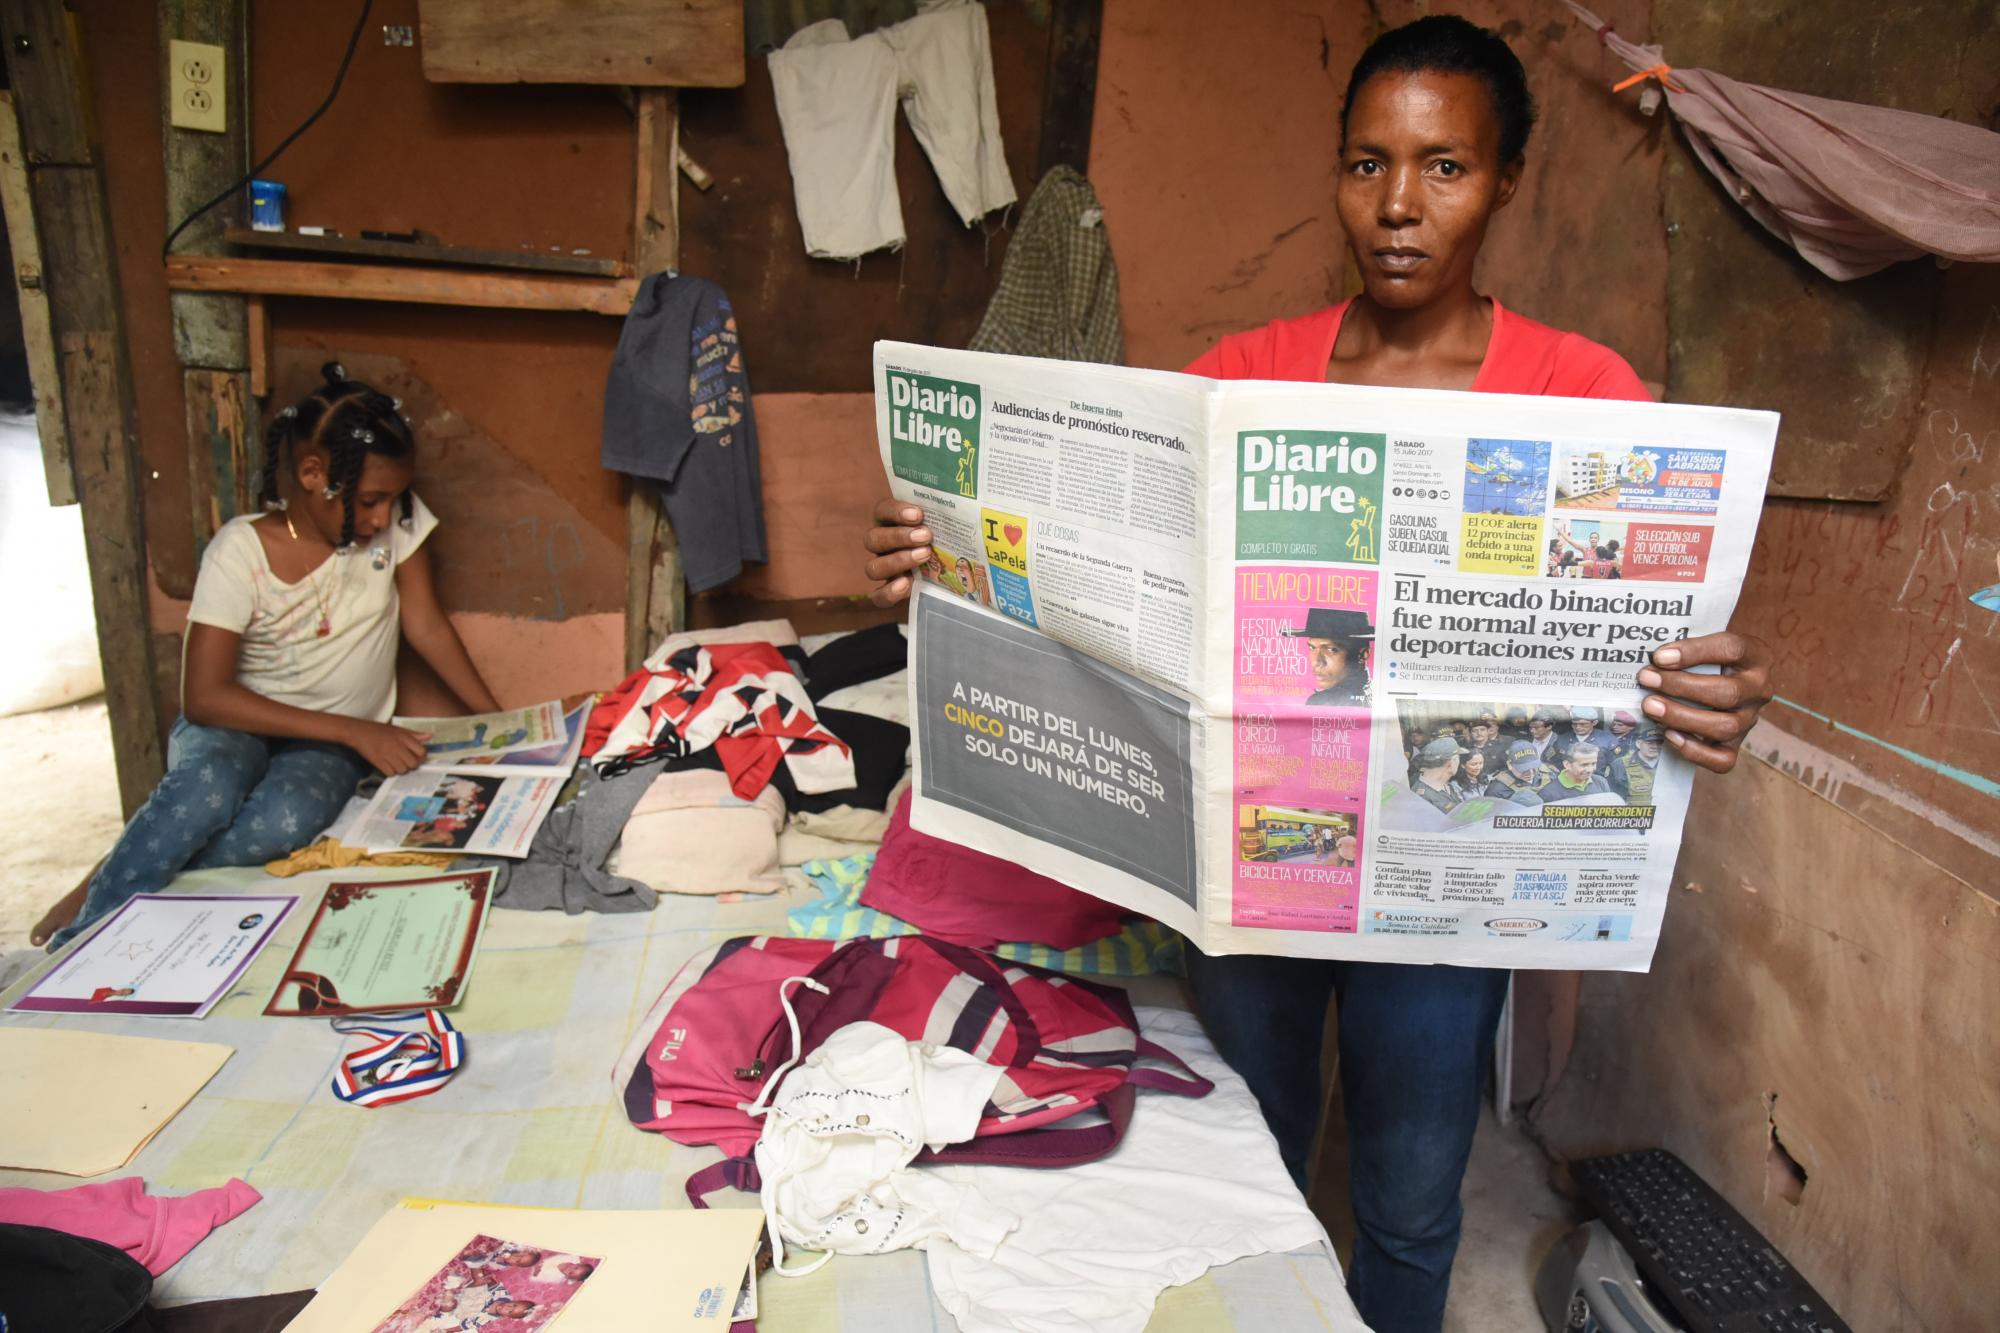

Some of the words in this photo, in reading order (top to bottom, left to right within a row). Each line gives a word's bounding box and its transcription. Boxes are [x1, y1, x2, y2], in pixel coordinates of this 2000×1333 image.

[891, 376, 976, 420] Diario
[1071, 401, 1080, 409] De
[1082, 402, 1104, 415] buena
[1106, 406, 1122, 418] tinta
[992, 401, 1049, 422] Audiencias
[1053, 411, 1065, 424] de
[1068, 416, 1129, 437] pronóstico
[894, 409, 961, 452] Libre
[1394, 440, 1424, 448] SÁBADO
[1244, 435, 1377, 475] Diario
[1667, 455, 1688, 463] SAN
[1690, 455, 1723, 464] ISIDRO
[1667, 462, 1721, 470] LABRADOR
[1243, 475, 1355, 513] Libre
[1390, 514, 1437, 528] GASOLINAS
[1468, 517, 1478, 527] El
[1481, 519, 1504, 528] COE
[1507, 520, 1537, 530] alerta
[986, 519, 998, 541] I
[1054, 526, 1079, 543] COSAS
[1420, 530, 1448, 542] GASOIL
[1467, 529, 1477, 537] 12
[1480, 530, 1535, 543] provincias
[1635, 530, 1681, 541] SELECCIÓN
[1683, 532, 1700, 543] SUB
[1241, 543, 1281, 554] COMPLETO
[1283, 544, 1288, 553] Y
[1290, 544, 1317, 555] GRATIS
[1388, 541, 1398, 551] SE
[1400, 542, 1426, 554] QUEDA
[1428, 544, 1450, 555] IGUAL
[1466, 539, 1501, 550] debido
[1513, 543, 1532, 552] una
[1634, 543, 1645, 553] 20
[1650, 544, 1687, 554] VOLEIBOL
[986, 546, 1026, 570] LaPela
[1037, 542, 1044, 550] Un
[1046, 545, 1070, 556] recuerdo
[1086, 555, 1110, 568] Segunda
[1112, 561, 1132, 573] Guerra
[1465, 551, 1491, 560] onda
[1494, 552, 1534, 563] tropical
[1633, 554, 1659, 565] VENCE
[1662, 554, 1698, 566] POLONIA
[1143, 570, 1161, 581] Buena
[1163, 575, 1185, 587] manera
[1151, 581, 1167, 591] pedir
[1168, 586, 1189, 598] perdón
[1240, 573, 1311, 601] TIEMPO
[1316, 575, 1371, 605] LIBRE
[1395, 580, 1419, 602] El
[1426, 587, 1543, 610] mercado
[1551, 582, 1693, 616] binacional
[998, 596, 1033, 622] Pazz
[1241, 619, 1292, 636] FESTIVAL
[1392, 607, 1432, 630] fue
[1439, 615, 1535, 635] normal
[1543, 620, 1601, 642] ayer
[1607, 625, 1668, 643] pese
[1674, 627, 1690, 640] a
[1241, 637, 1302, 656] NACIONAL
[1390, 634, 1573, 661] deportaciones
[1240, 656, 1258, 674] DE
[1262, 656, 1307, 675] TEATRO
[1400, 662, 1442, 672] Militares
[1444, 664, 1481, 674] realizan
[1484, 666, 1522, 676] redadas
[1539, 668, 1588, 681] provincias
[1590, 670, 1602, 679] de
[1605, 670, 1632, 680] Línea
[1399, 672, 1411, 681] Se
[1413, 672, 1454, 682] incautan
[1456, 674, 1467, 683] de
[1468, 674, 1502, 684] carnés
[1504, 676, 1557, 687] falsificados
[1560, 678, 1575, 687] del
[1577, 679, 1599, 689] Plan
[953, 682, 966, 702] A
[971, 687, 1039, 726] PARTIR
[1044, 712, 1084, 741] DEL
[1089, 727, 1158, 777] LUNES,
[1312, 716, 1360, 729] FESTIVAL
[1239, 726, 1276, 743] CIRCO
[1311, 728, 1325, 742] DE
[1328, 729, 1351, 744] CINE
[945, 703, 1004, 737] CINCO
[1009, 725, 1090, 768] DEJARÁ
[1096, 755, 1123, 782] DE
[1127, 769, 1165, 802] SER
[1311, 744, 1352, 759] INFANTIL
[965, 735, 1018, 766] SOLO
[1023, 754, 1051, 778] UN
[1057, 766, 1150, 818] NÚMERO.
[1544, 807, 1586, 816] SEGUNDO
[1588, 807, 1653, 817] EXPRESIDENTE
[1496, 818, 1508, 827] EN
[1509, 818, 1544, 828] CUERDA
[1546, 818, 1572, 828] FLOJA
[1575, 818, 1593, 828] POR
[1595, 817, 1651, 828] CORRUPCIÓN
[1240, 865, 1291, 881] BICICLETA
[1294, 868, 1301, 880] Y
[1303, 869, 1353, 885] CERVEZA
[1390, 875, 1432, 884] Gobierno
[1411, 869, 1432, 877] plan
[1445, 872, 1484, 880] Emitirán
[1579, 873, 1612, 881] Marcha
[1374, 881, 1406, 889] abarate
[1408, 883, 1431, 891] valor
[1451, 879, 1498, 888] imputados
[1523, 883, 1568, 891] ASPIRANTES
[1577, 881, 1603, 889] aspira
[1374, 889, 1384, 897] de
[1386, 890, 1428, 899] viviendas
[1442, 894, 1479, 902] próximo
[1481, 895, 1504, 903] lunes
[1576, 888, 1594, 896] más
[1596, 889, 1619, 897] gente
[1622, 889, 1638, 897] que
[1386, 914, 1459, 924] RADIOCENTRO
[1493, 921, 1538, 929] AMERICAN
[659, 1027, 686, 1062] FILA
